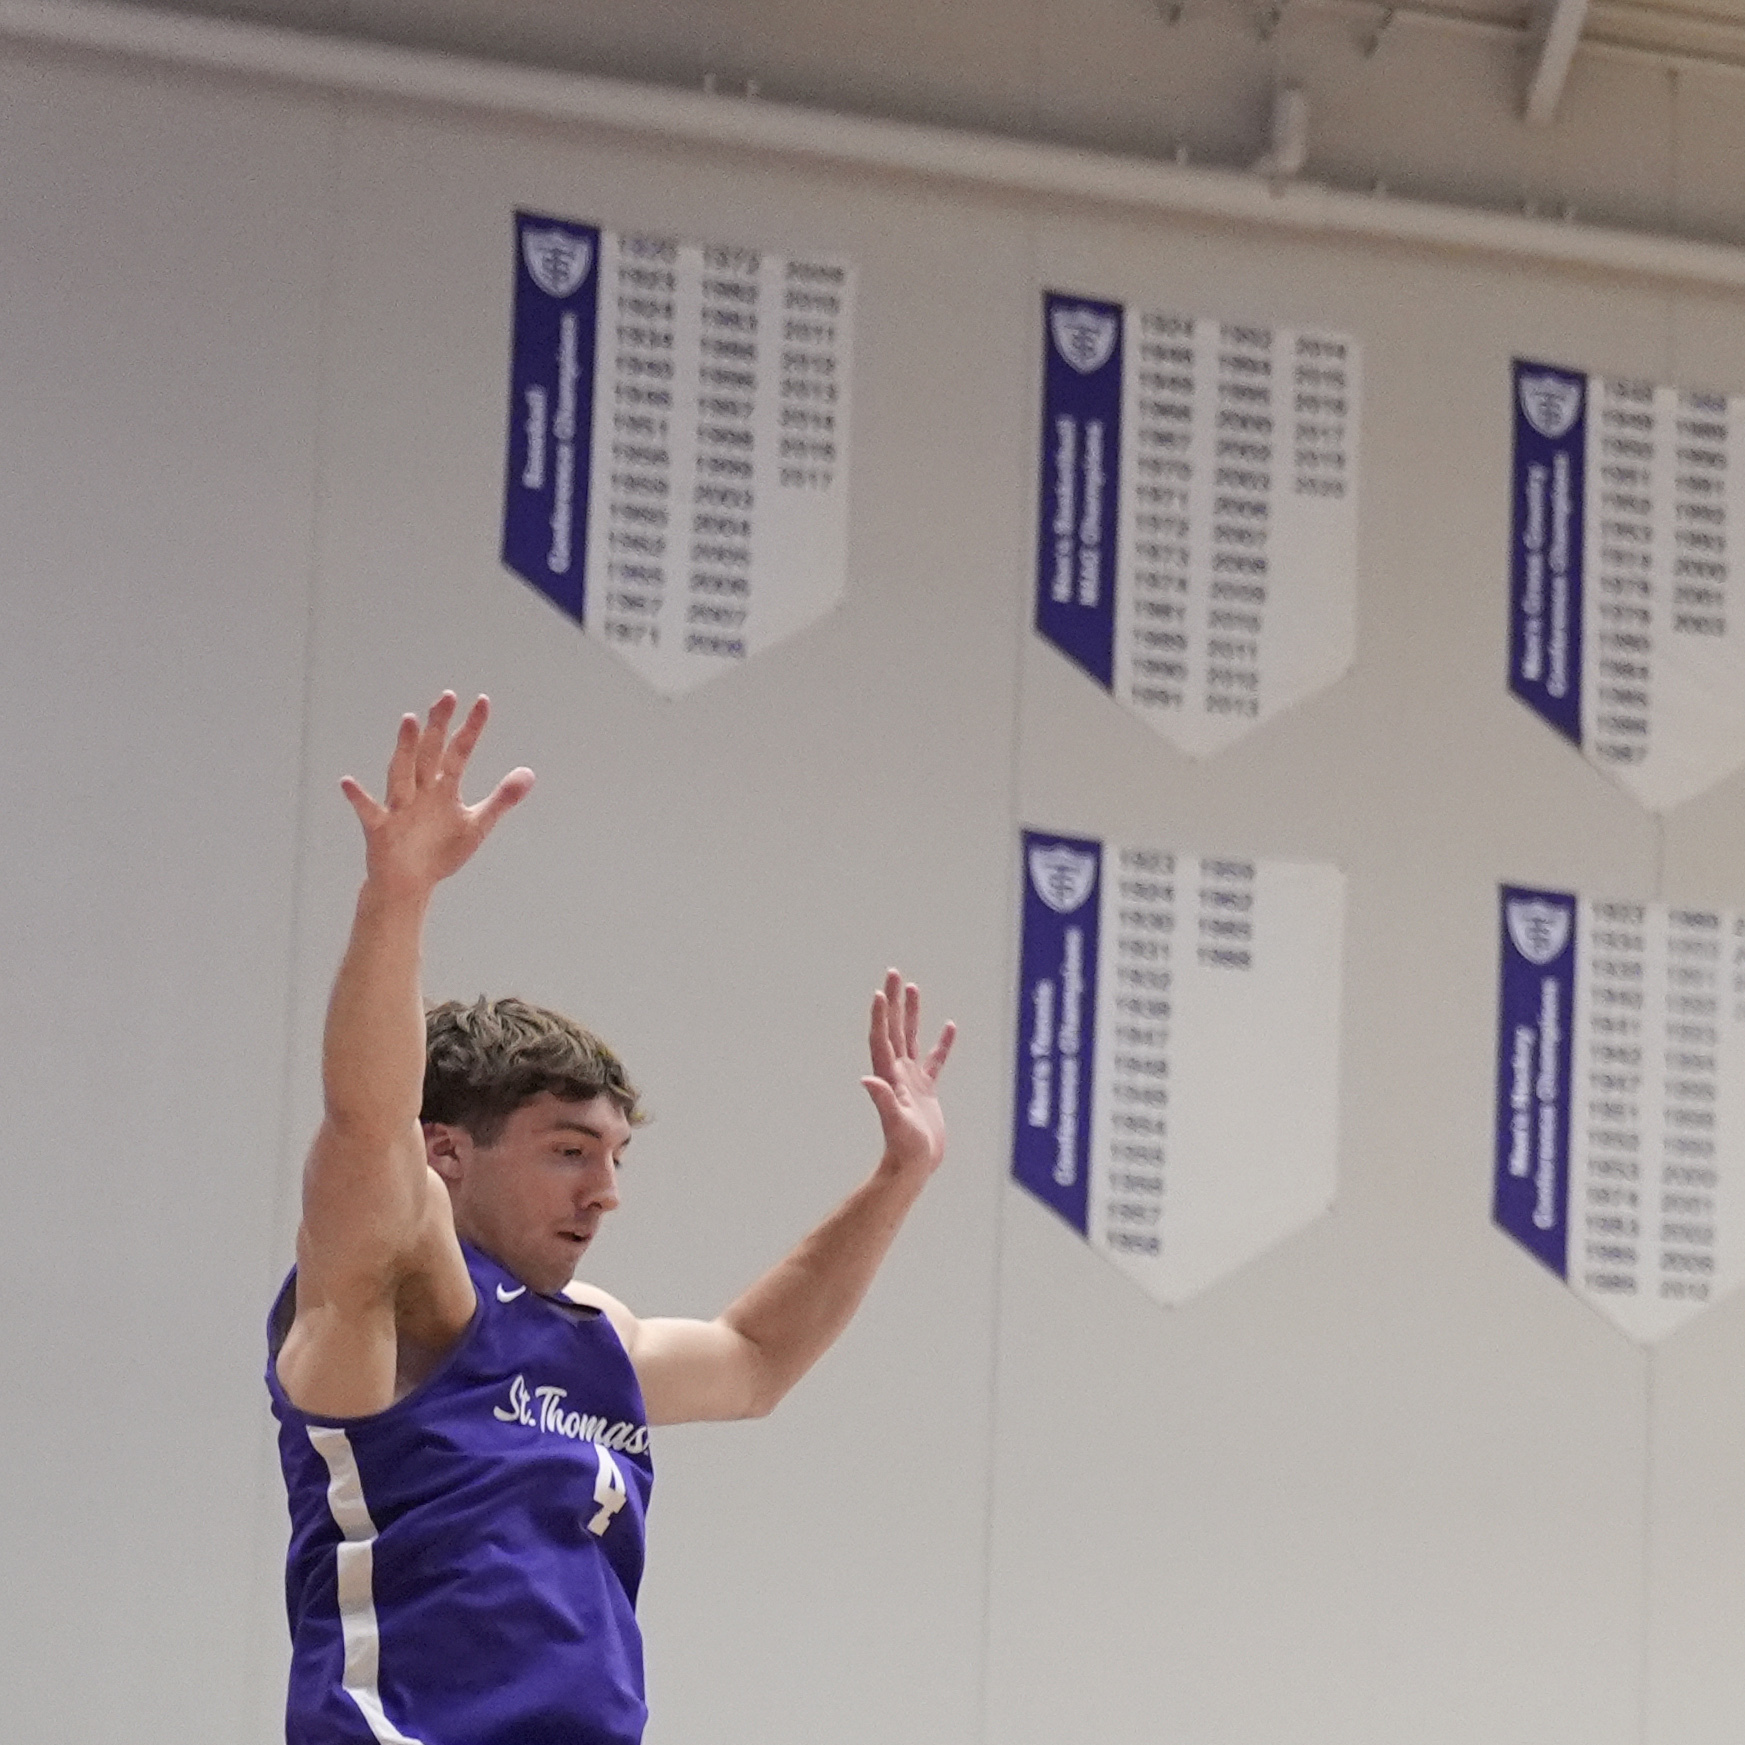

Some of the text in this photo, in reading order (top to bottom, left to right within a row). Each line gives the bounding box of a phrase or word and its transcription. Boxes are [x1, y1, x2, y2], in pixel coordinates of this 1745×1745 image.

[1052, 414, 1076, 535] Basketball
[1079, 419, 1106, 607] MIAC Champions
[587, 1443, 627, 1537] 4
